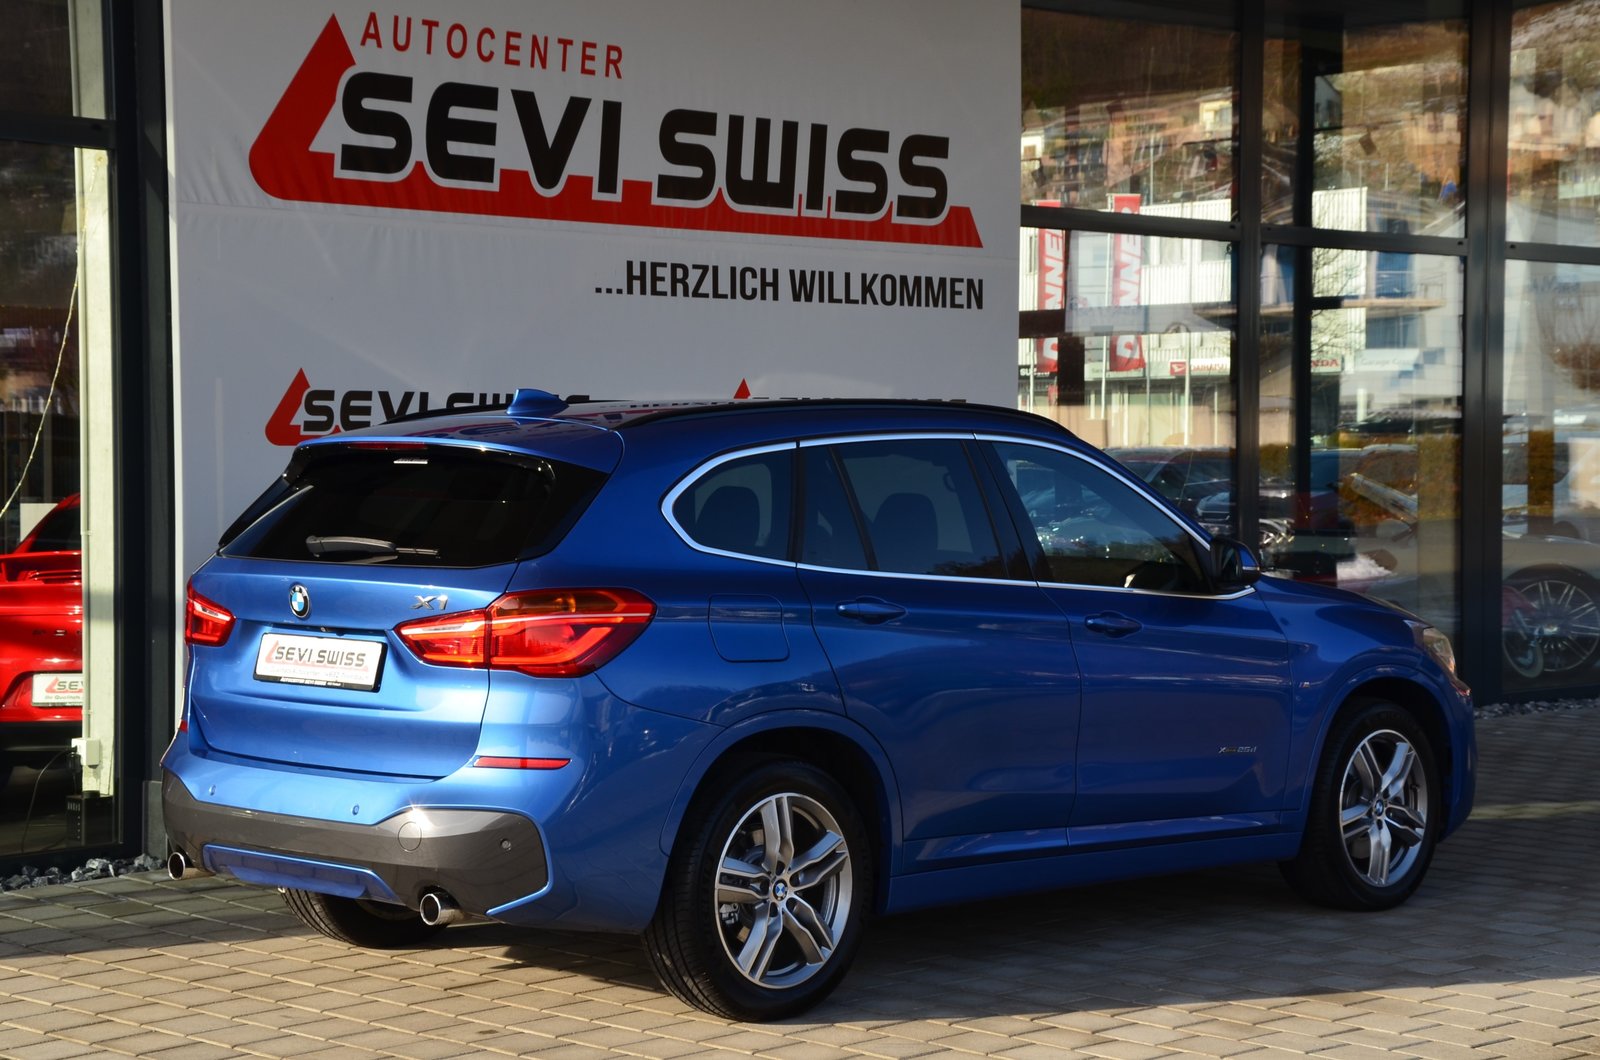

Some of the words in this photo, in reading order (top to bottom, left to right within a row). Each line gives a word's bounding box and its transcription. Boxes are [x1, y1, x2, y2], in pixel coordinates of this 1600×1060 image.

[360, 11, 623, 80] AUTOCENTER
[339, 71, 622, 195] SEVI
[657, 108, 950, 219] SWISS
[789, 269, 984, 310] WILLKOMMEN
[412, 594, 448, 610] X1
[275, 646, 312, 662] SEVI
[316, 649, 366, 667] SWISS
[57, 681, 83, 690] SE
